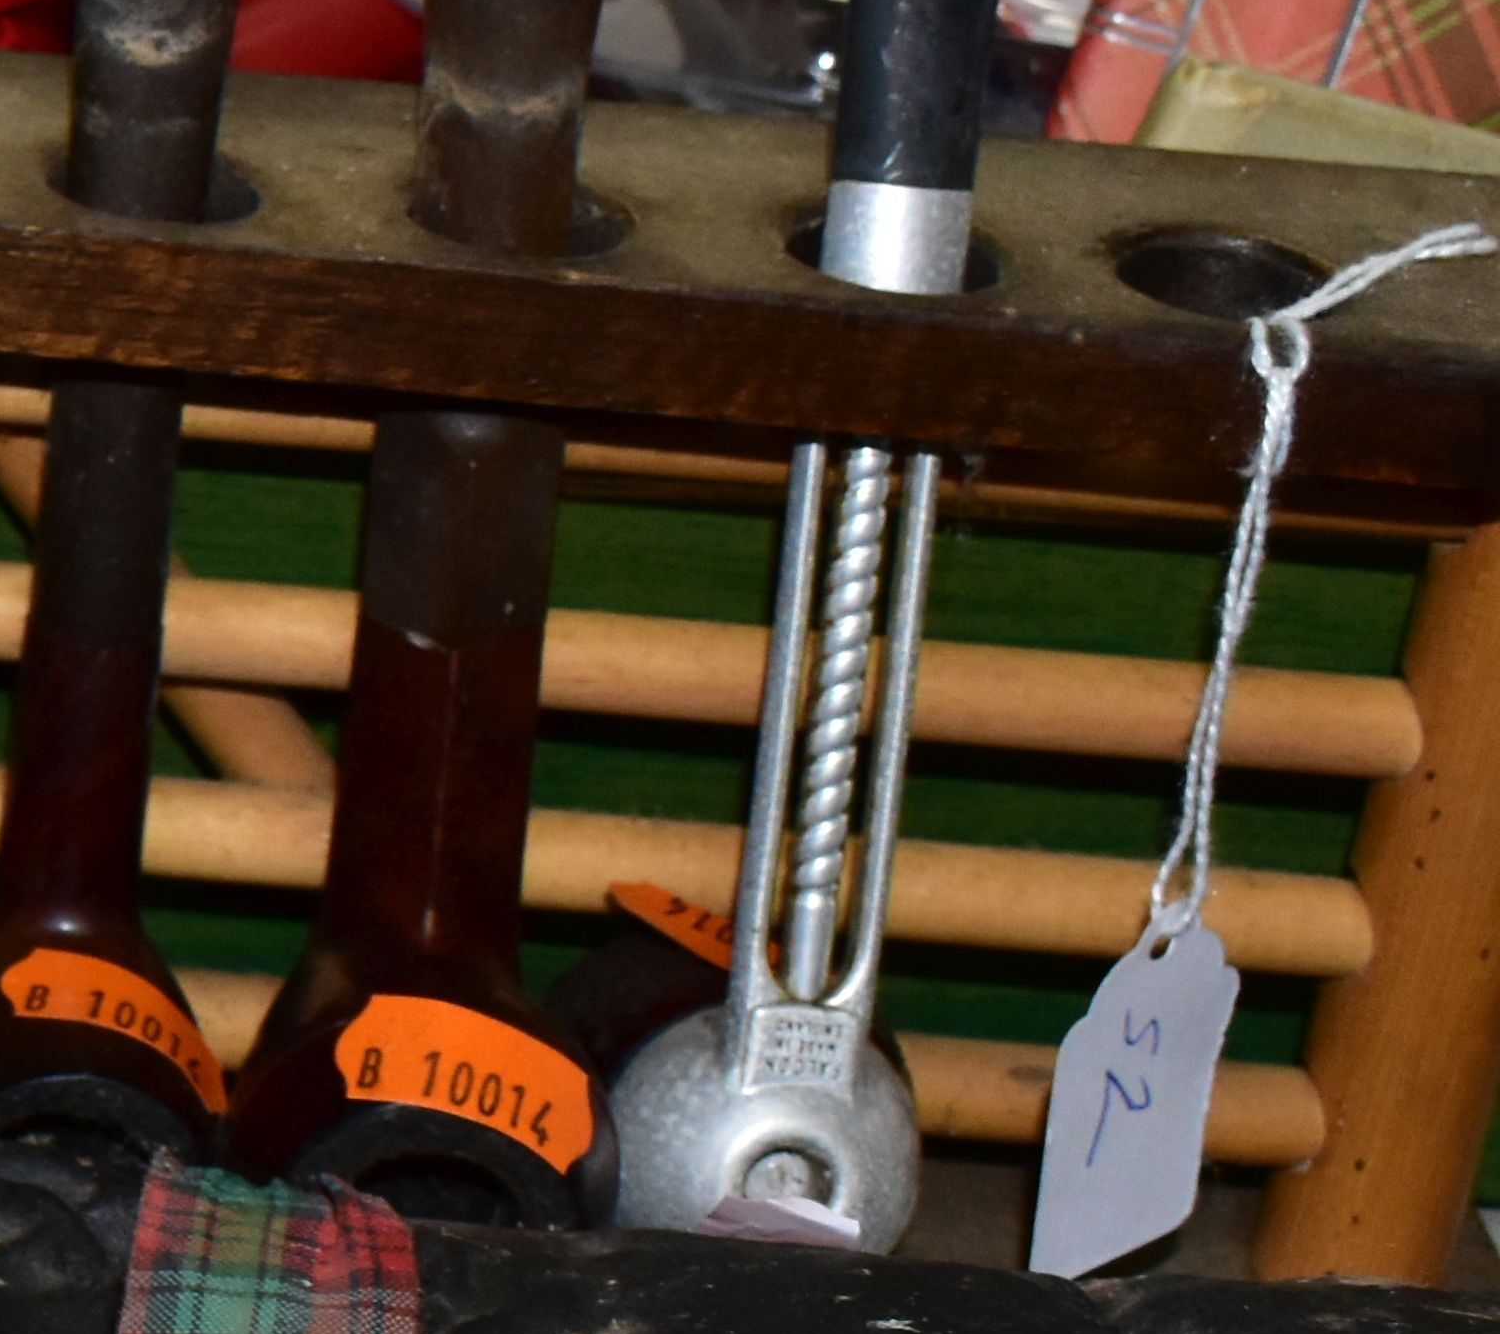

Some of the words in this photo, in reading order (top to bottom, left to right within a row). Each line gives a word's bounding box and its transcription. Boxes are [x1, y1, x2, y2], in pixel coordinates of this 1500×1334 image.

[23, 983, 50, 1012] B
[357, 1046, 383, 1089] B
[422, 1050, 552, 1148] 10014
